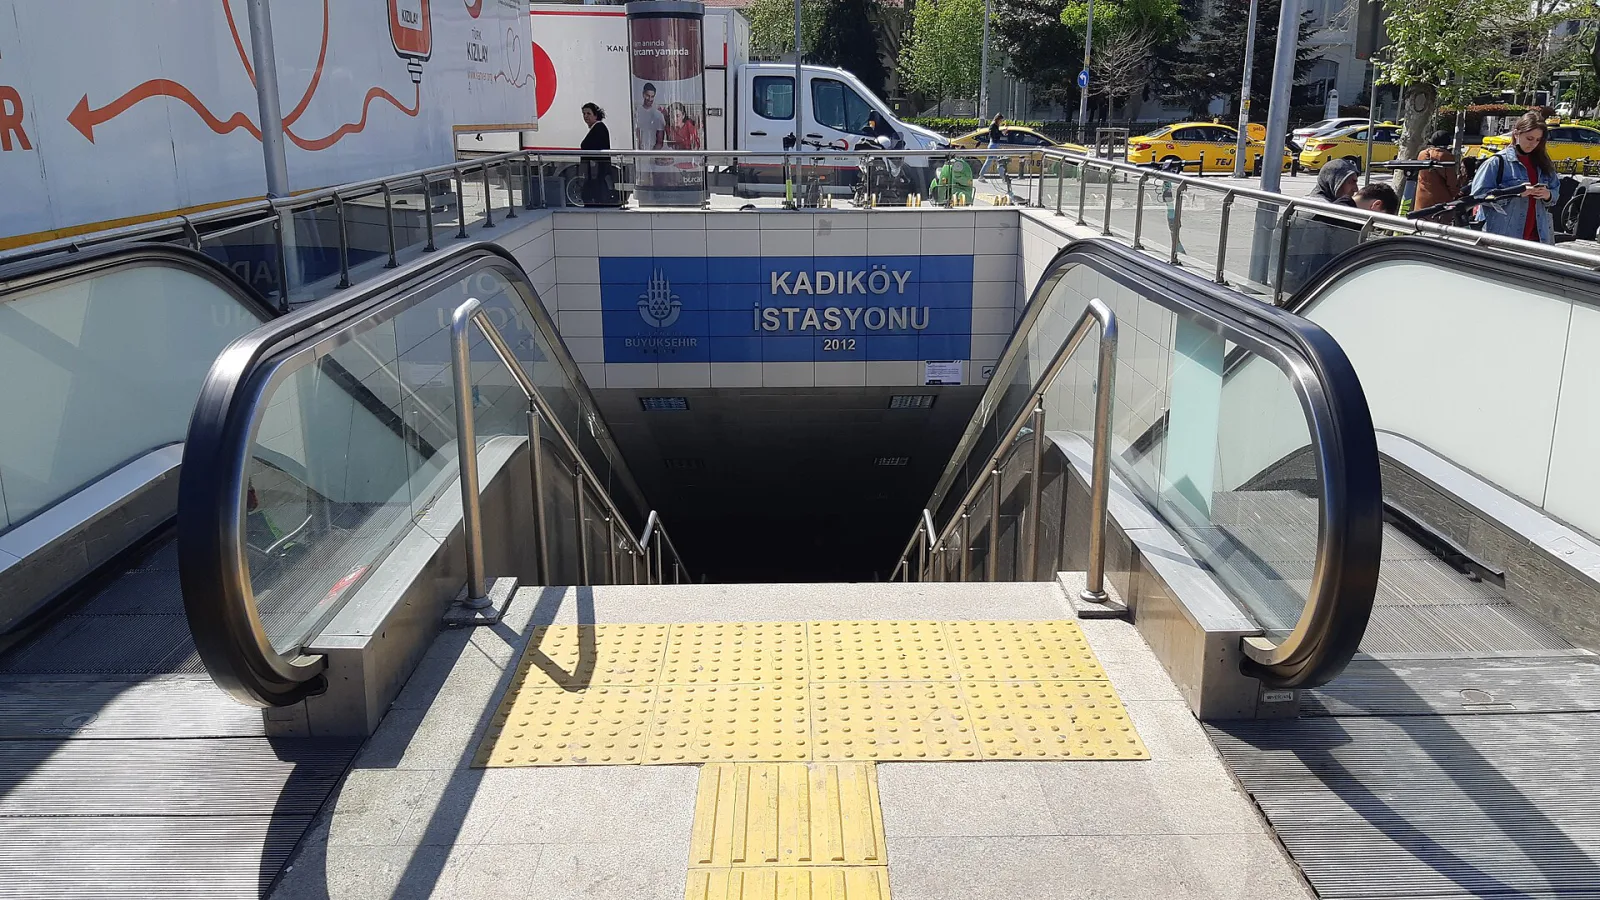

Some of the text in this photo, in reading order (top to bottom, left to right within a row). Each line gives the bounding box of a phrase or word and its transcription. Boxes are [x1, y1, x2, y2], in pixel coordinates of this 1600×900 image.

[401, 8, 419, 24] KIZILAY
[466, 42, 488, 62] KIZILAY
[654, 47, 689, 57] yanında
[0, 86, 33, 151] R
[1215, 158, 1233, 166] TEJ
[771, 264, 912, 295] KADIKÖY
[754, 302, 930, 331] İSTASYONU
[823, 338, 856, 351] 2012
